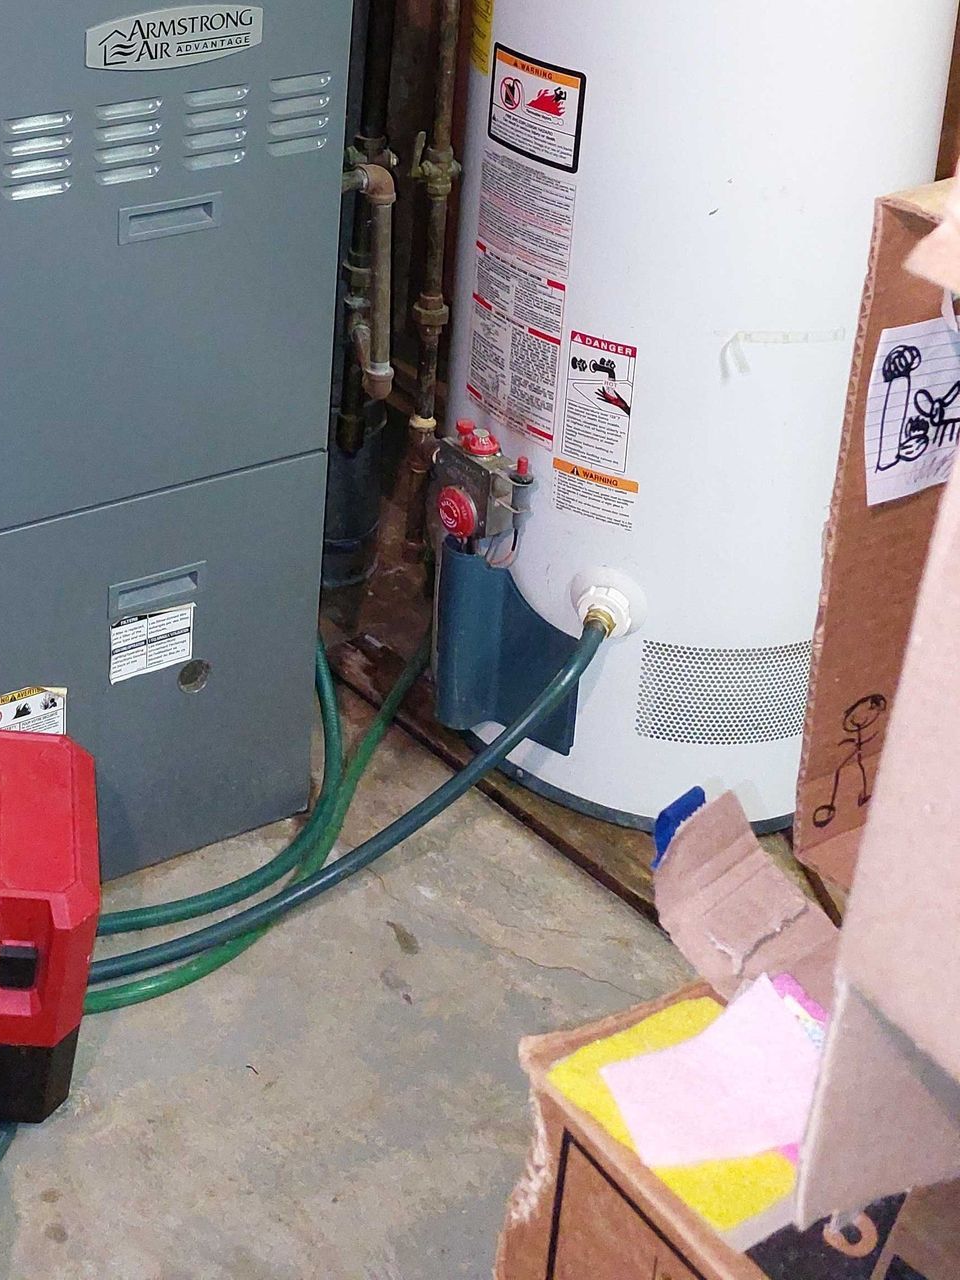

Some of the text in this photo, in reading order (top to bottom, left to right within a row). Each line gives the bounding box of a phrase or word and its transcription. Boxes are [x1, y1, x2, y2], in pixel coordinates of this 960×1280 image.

[127, 8, 254, 42] ARMSTRONG
[134, 35, 251, 63] AIR ADVANTAGE
[521, 63, 553, 80] WARNING
[585, 338, 633, 357] DANGER
[603, 379, 619, 389] HOT
[581, 470, 619, 487] WARNING
